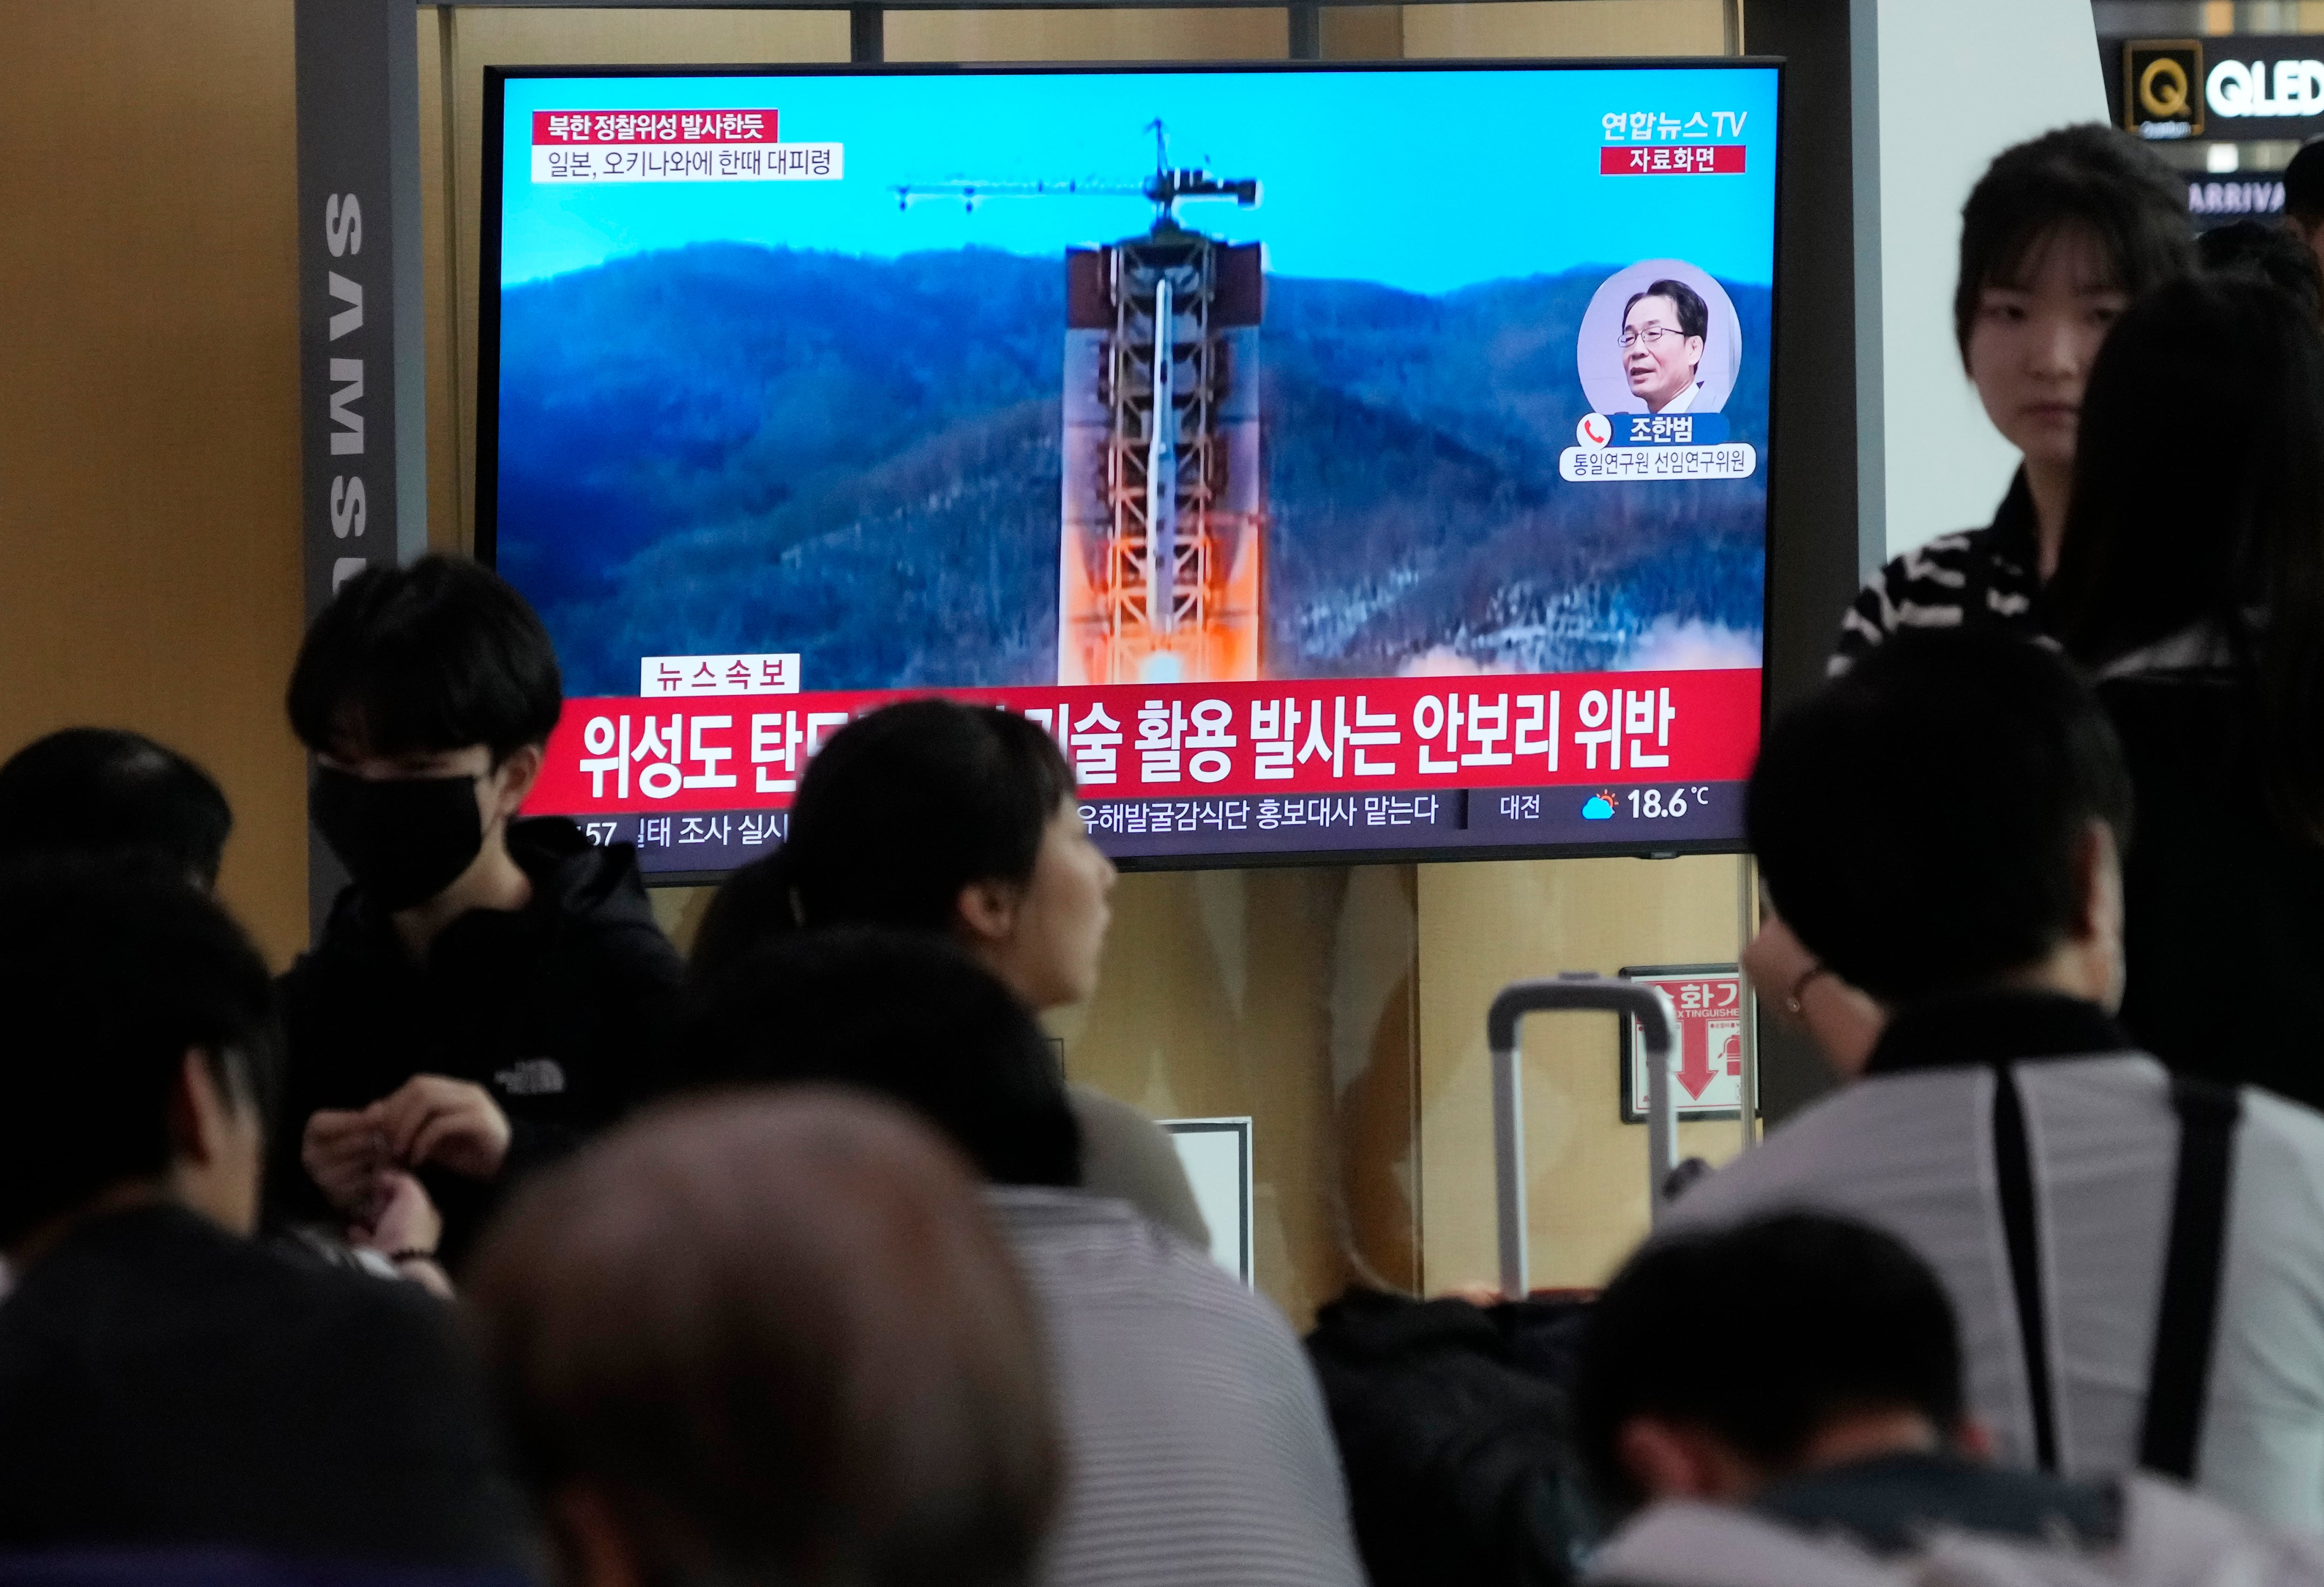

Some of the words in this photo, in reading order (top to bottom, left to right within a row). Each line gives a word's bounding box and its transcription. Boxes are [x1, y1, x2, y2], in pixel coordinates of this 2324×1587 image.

[2205, 59, 2324, 118] QLED
[548, 115, 591, 141] 북한
[594, 114, 676, 141] 정찰위성
[681, 113, 764, 139] 발사한듯
[1602, 111, 1748, 140] 연합뉴스TV
[548, 152, 597, 179] 일본,
[602, 151, 713, 176] 오키나와에
[719, 150, 761, 175] 한때
[768, 149, 831, 175] 대피령
[1630, 147, 1714, 173] 자료화면
[1629, 416, 1693, 443] 조한범
[1574, 452, 1649, 475] 통일연구원
[1655, 450, 1745, 474] 선임연구위원
[657, 659, 786, 691] 뉴스속보
[579, 713, 737, 799] 위성도
[1135, 698, 1237, 783] 활용
[1250, 695, 1401, 780] 발사는
[1413, 690, 1560, 774] 안보리
[1575, 687, 1676, 770] 위반
[1256, 797, 1358, 830] 홍보대사
[1365, 794, 1440, 825] 맡는다
[1500, 794, 1541, 820] 대전
[678, 815, 731, 845] 조사
